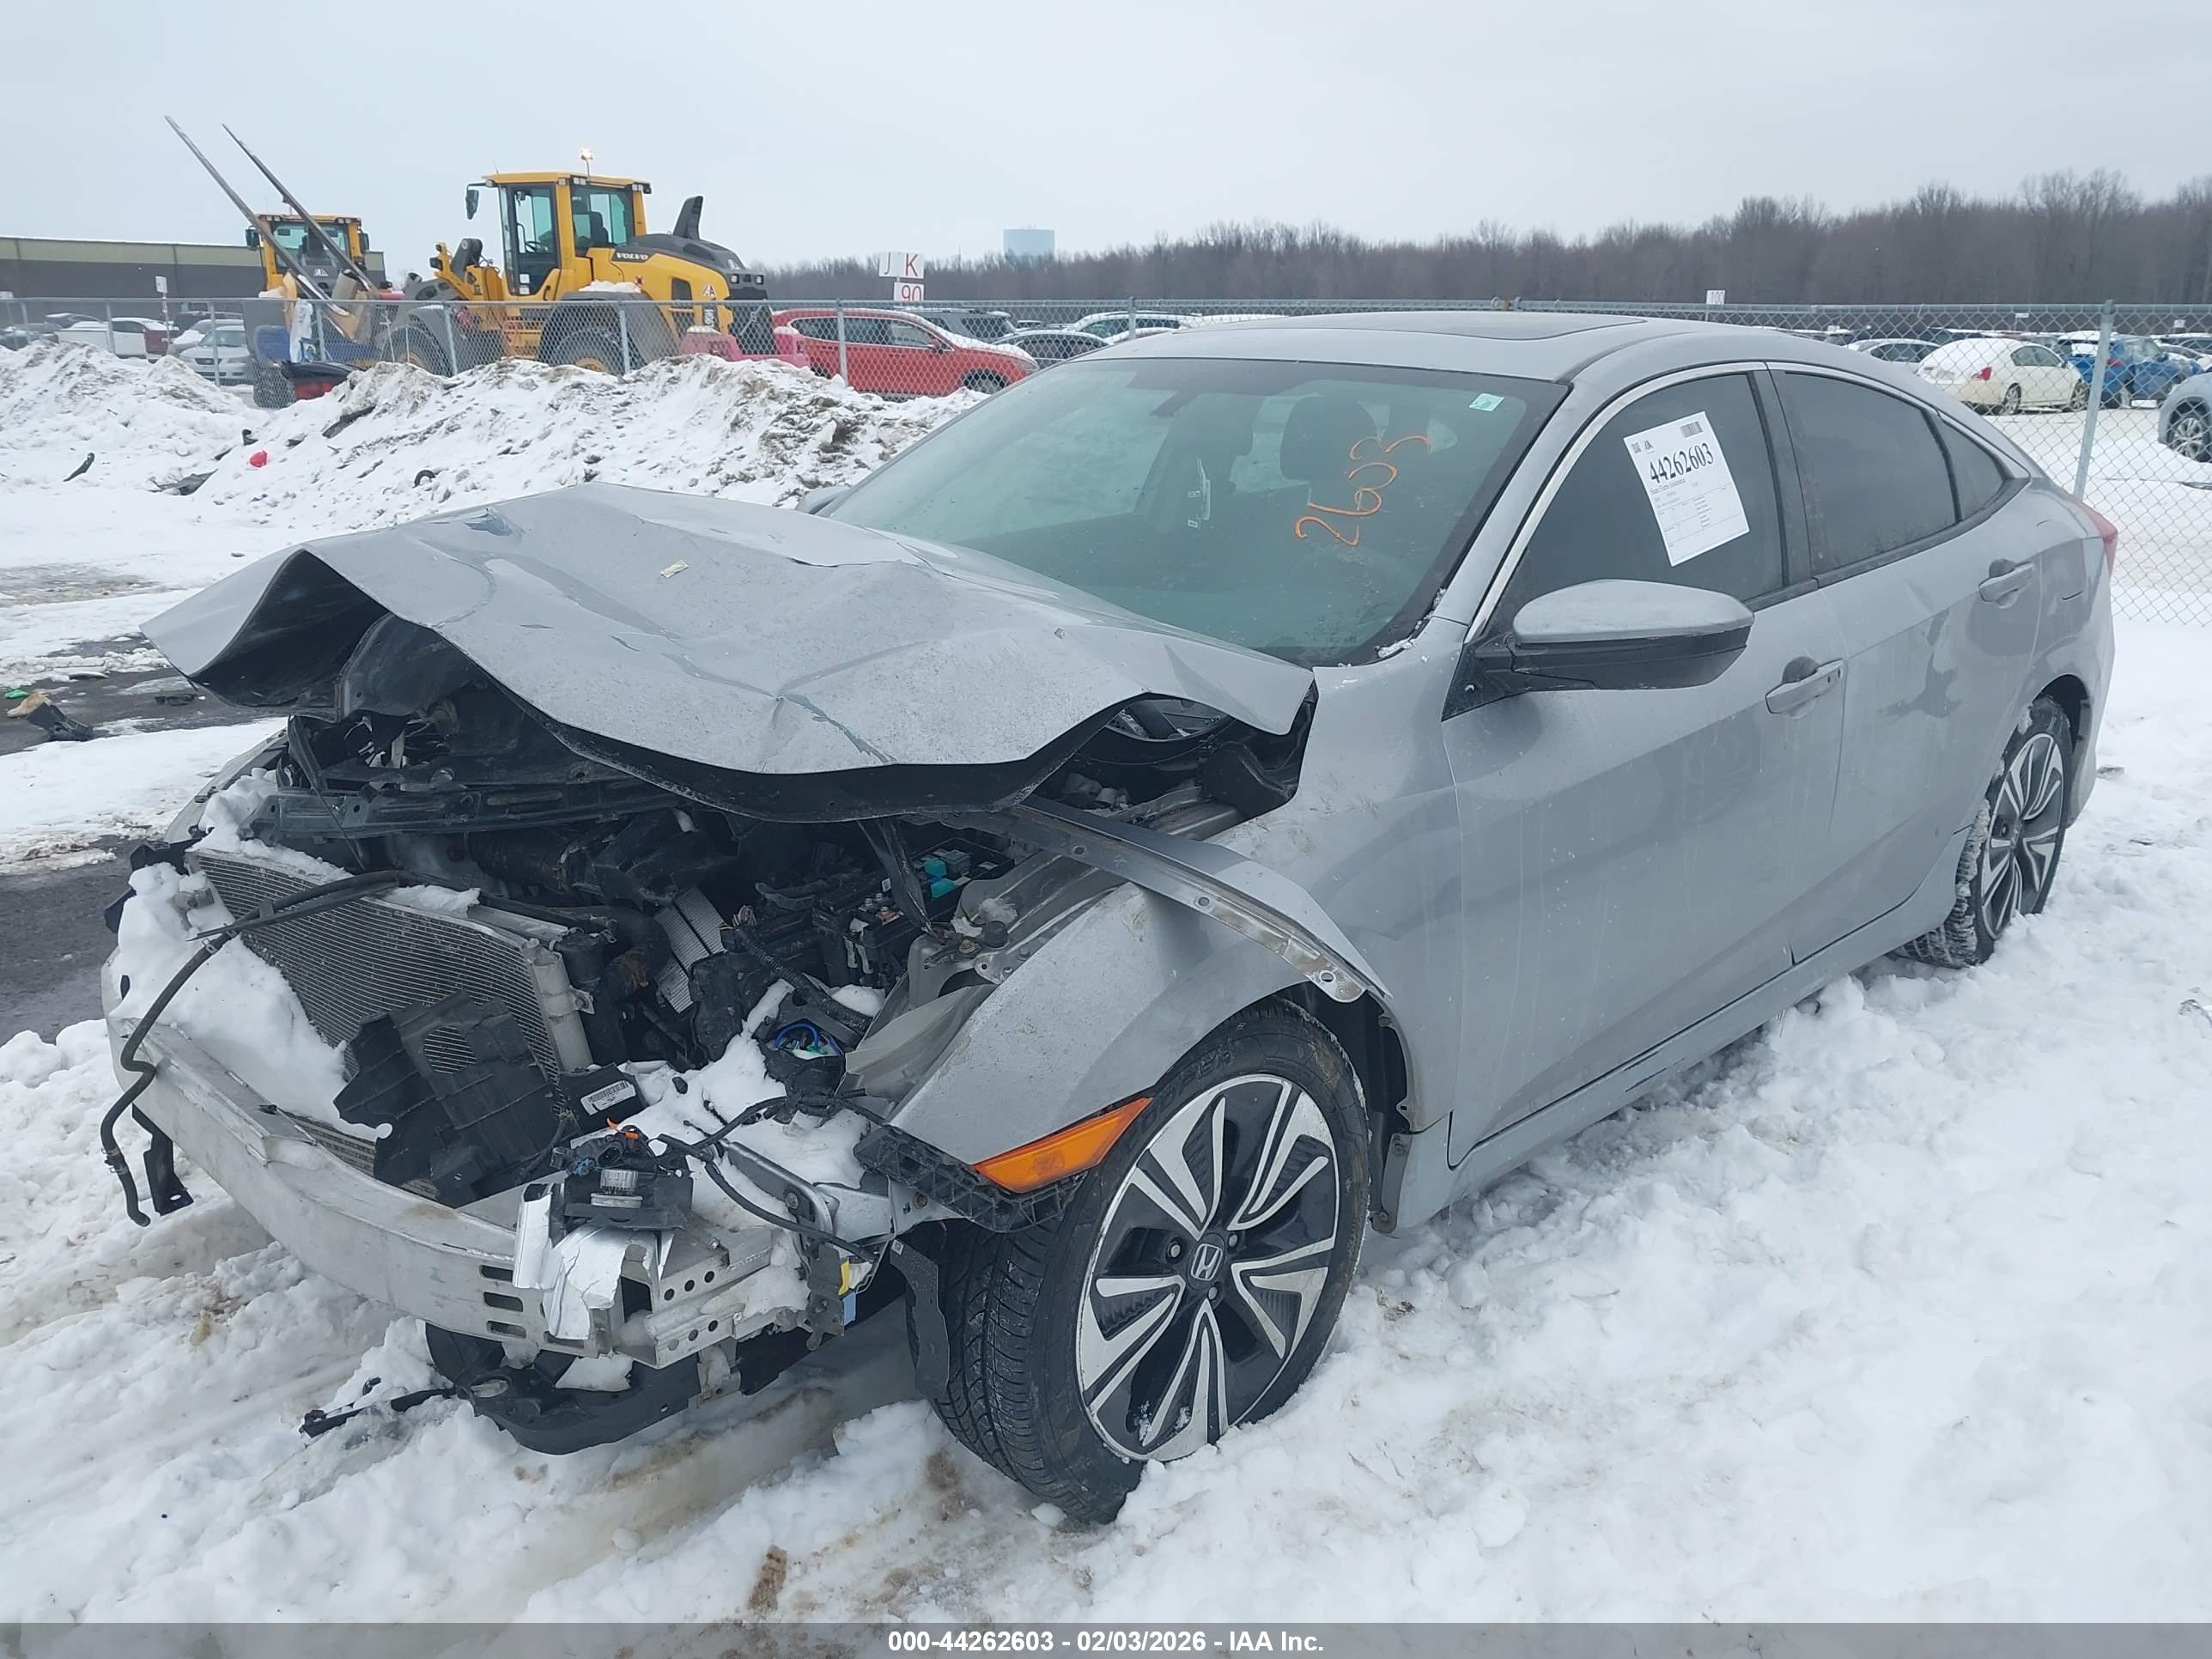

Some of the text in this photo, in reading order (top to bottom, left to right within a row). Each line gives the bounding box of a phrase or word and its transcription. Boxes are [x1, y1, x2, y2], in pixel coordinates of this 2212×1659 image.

[884, 252, 918, 276] J K
[901, 284, 921, 301] 90
[1650, 442, 1714, 483] 44262603
[1295, 435, 1432, 545] 2603
